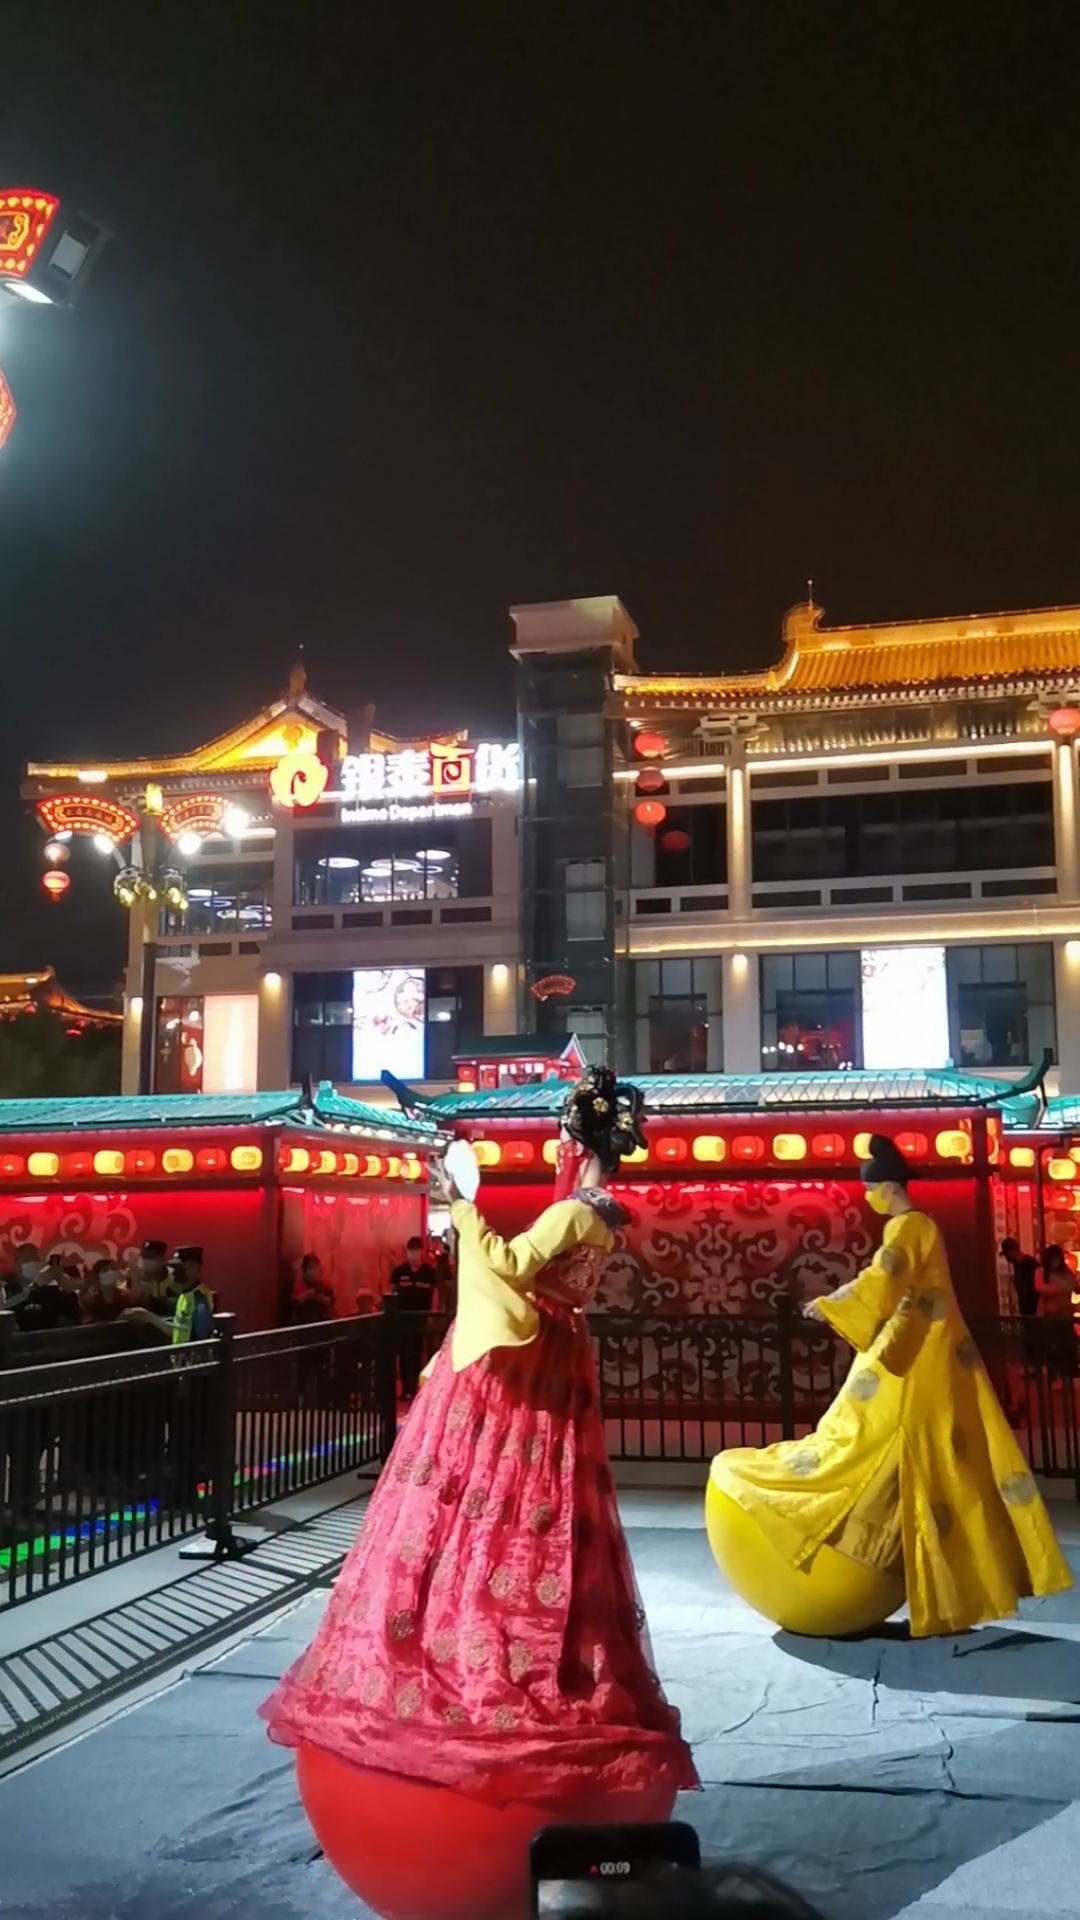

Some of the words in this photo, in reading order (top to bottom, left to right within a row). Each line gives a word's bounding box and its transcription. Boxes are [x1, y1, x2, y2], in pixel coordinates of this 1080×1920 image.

[340, 742, 521, 801] 银泰百货
[600, 1862, 631, 1875] 00:09
